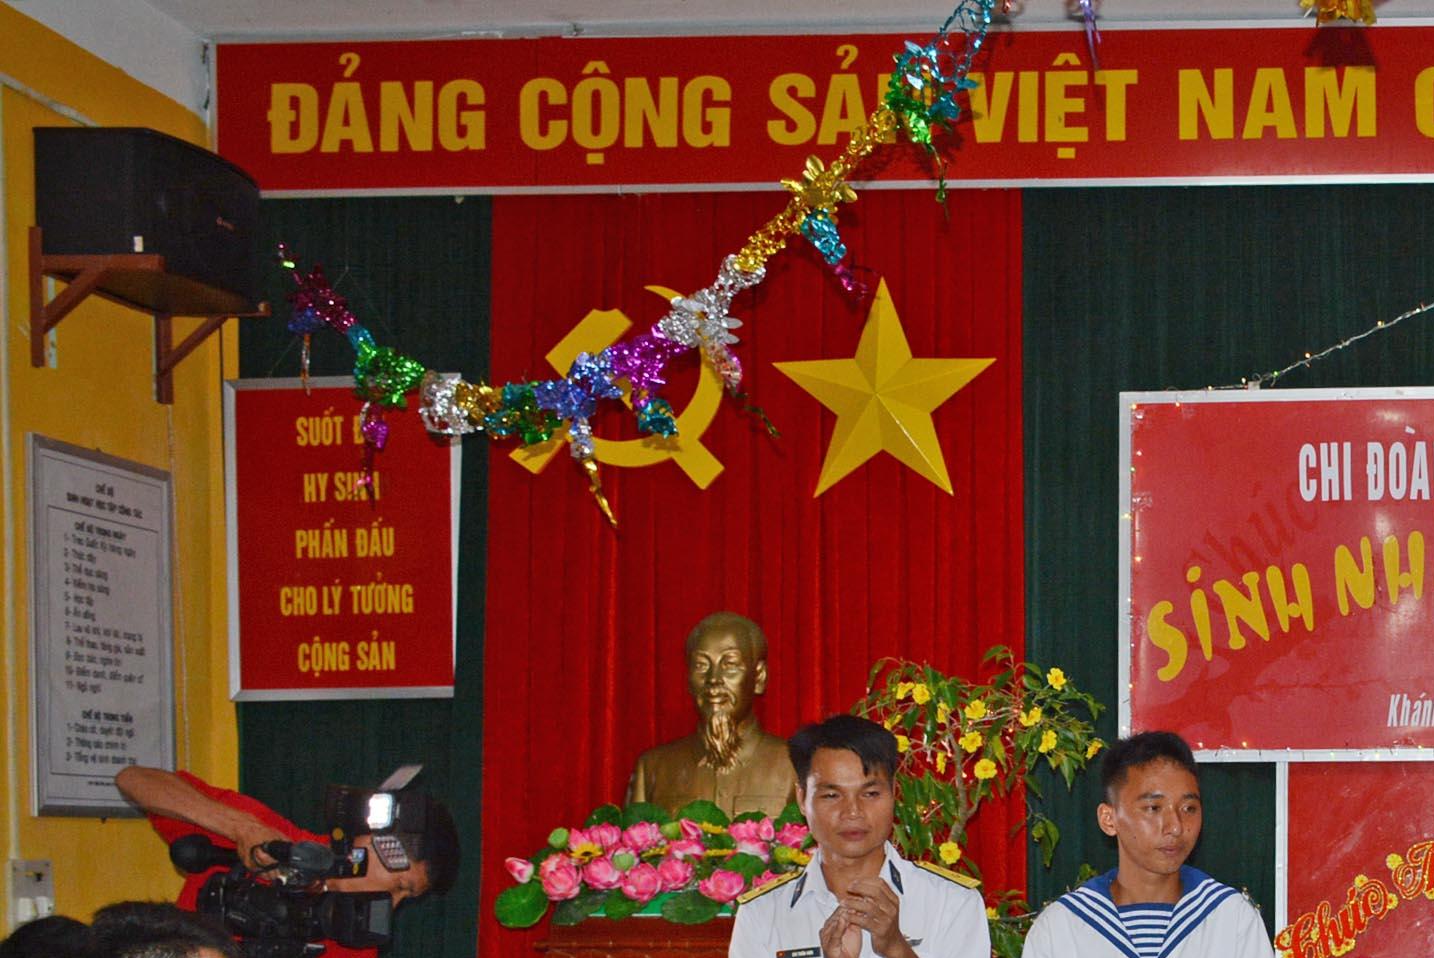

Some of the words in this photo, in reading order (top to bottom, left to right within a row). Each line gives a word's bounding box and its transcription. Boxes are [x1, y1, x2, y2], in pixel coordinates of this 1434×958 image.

[268, 53, 485, 153] ĐẢNG
[520, 61, 731, 164] CỘNG
[966, 52, 1137, 159] VIỆT
[1178, 66, 1377, 140] NAM
[295, 405, 344, 447] SUỐT
[303, 472, 329, 503] HY
[1299, 441, 1352, 502] CHI
[295, 518, 349, 559] PHẤN
[355, 517, 395, 558] ĐẤU
[280, 585, 318, 617] CHO
[322, 578, 342, 615] LÝ
[350, 572, 414, 615] TƯỞNG
[297, 635, 350, 677] CỘNG
[356, 630, 396, 671] SẢN
